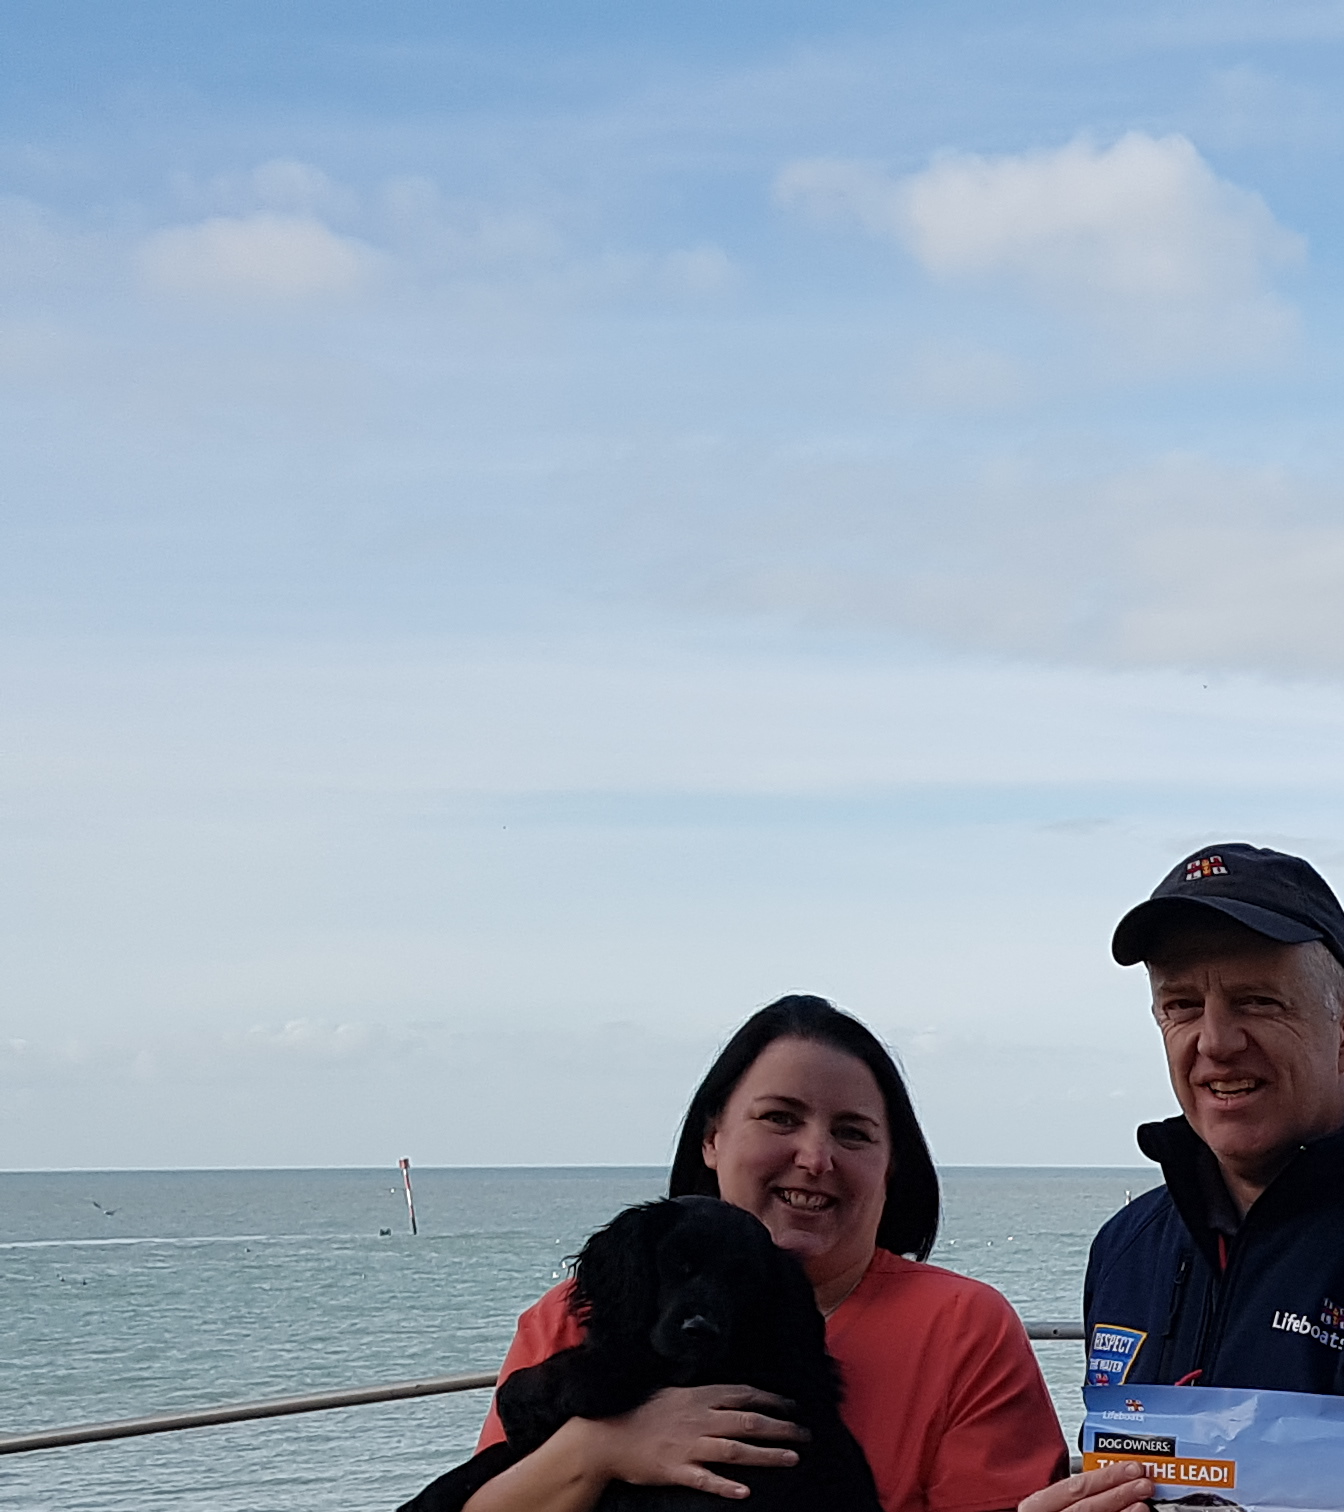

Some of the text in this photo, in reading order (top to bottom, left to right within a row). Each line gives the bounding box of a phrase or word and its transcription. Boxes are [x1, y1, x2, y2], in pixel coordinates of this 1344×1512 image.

[1093, 1332, 1134, 1354] RESPECT
[1098, 1438, 1121, 1449] DOG
[1142, 1462, 1176, 1479] THE
[1180, 1464, 1228, 1482] LEAD!
